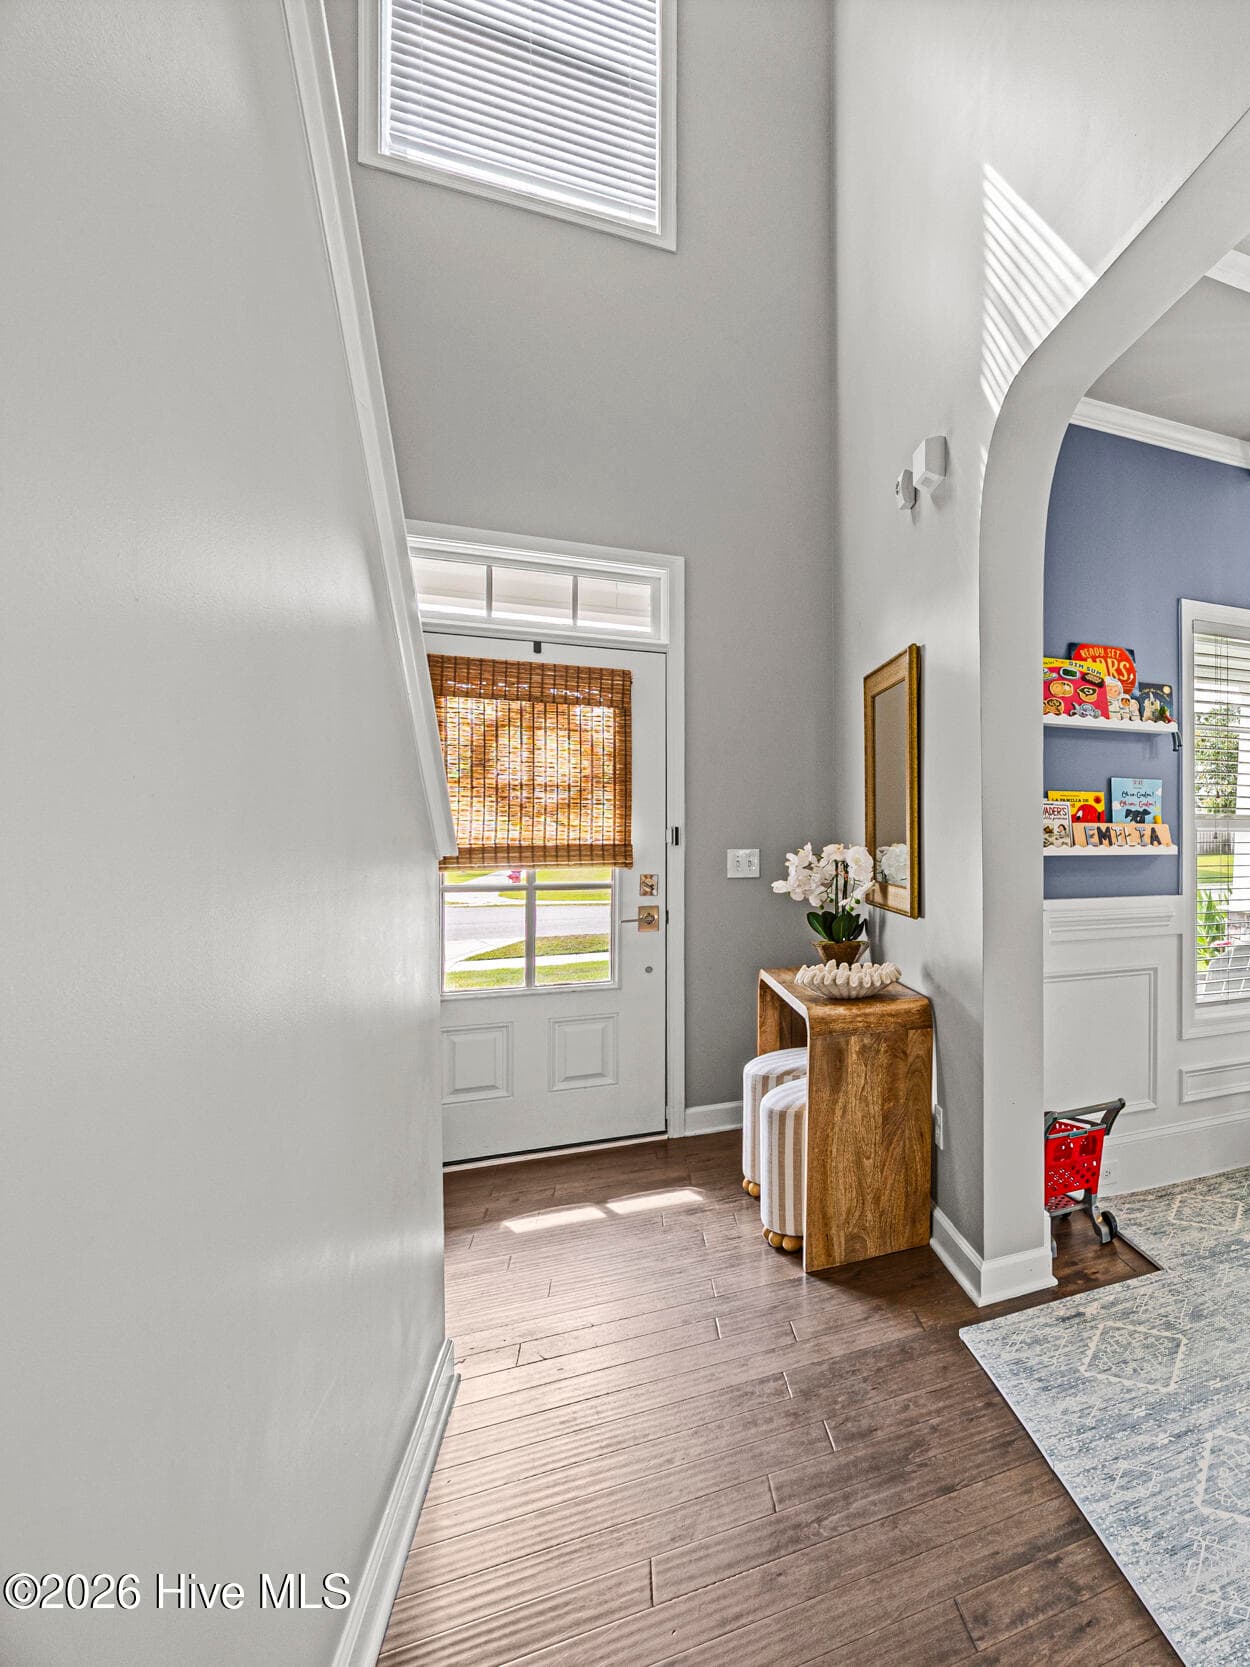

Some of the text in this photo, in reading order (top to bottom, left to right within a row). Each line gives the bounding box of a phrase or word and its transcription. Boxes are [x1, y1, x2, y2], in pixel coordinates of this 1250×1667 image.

[1068, 661, 1103, 676] DIM SUM
[1084, 825, 1162, 847] EMILIA
